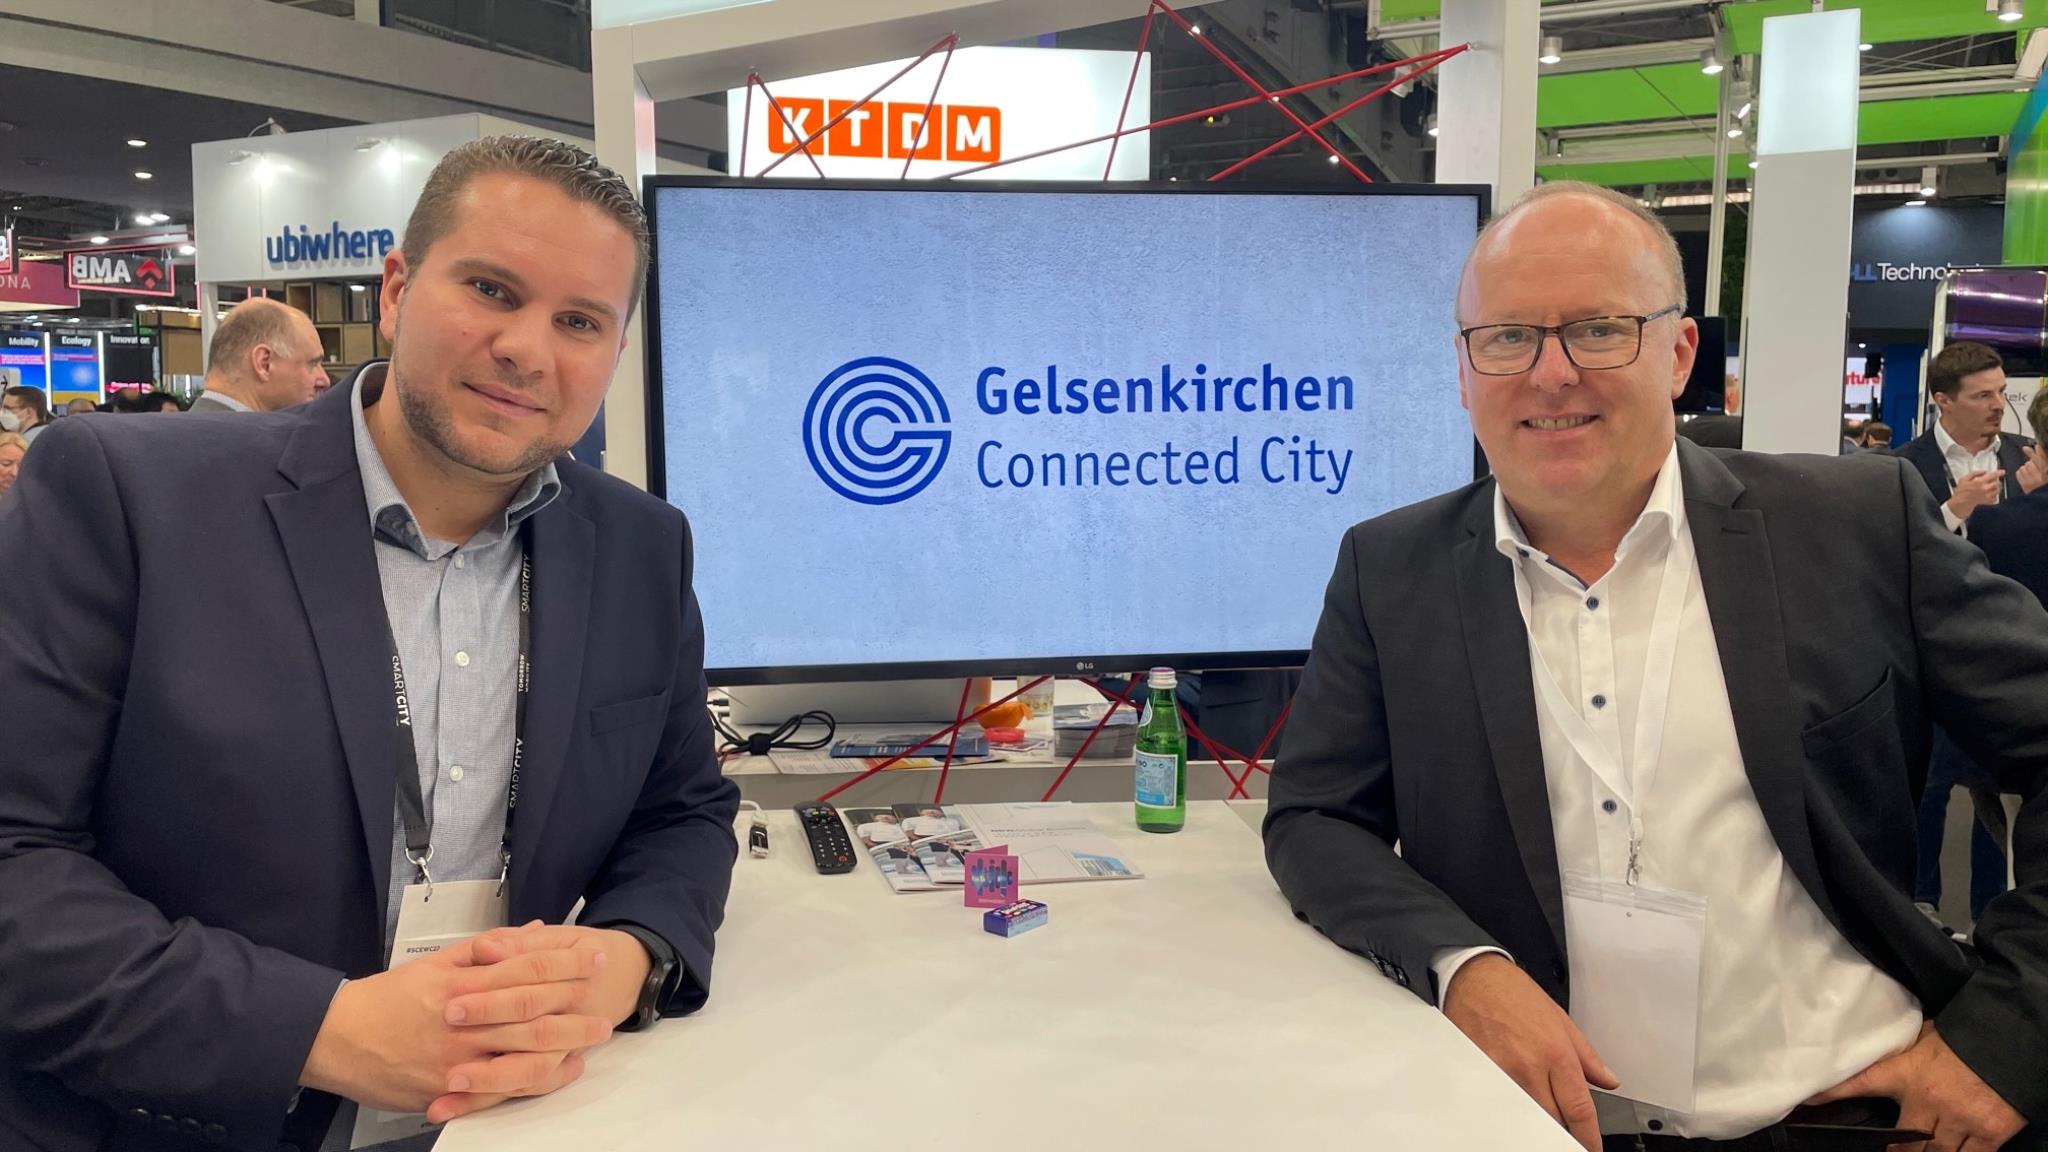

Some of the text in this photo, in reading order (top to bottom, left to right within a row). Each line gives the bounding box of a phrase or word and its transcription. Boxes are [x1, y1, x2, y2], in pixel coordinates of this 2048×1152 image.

[782, 106, 992, 153] KTDM
[266, 220, 394, 263] ubiwhere
[8, 337, 39, 348] Mobility
[61, 336, 92, 347] Ecology
[110, 335, 150, 344] Innovaton
[977, 362, 1354, 415] Gelsenkirchen
[977, 434, 1354, 496] Connected City
[520, 553, 531, 613] SMARTCITY
[392, 655, 411, 727] SMARTCITY
[509, 737, 524, 808] SMARTCITY
